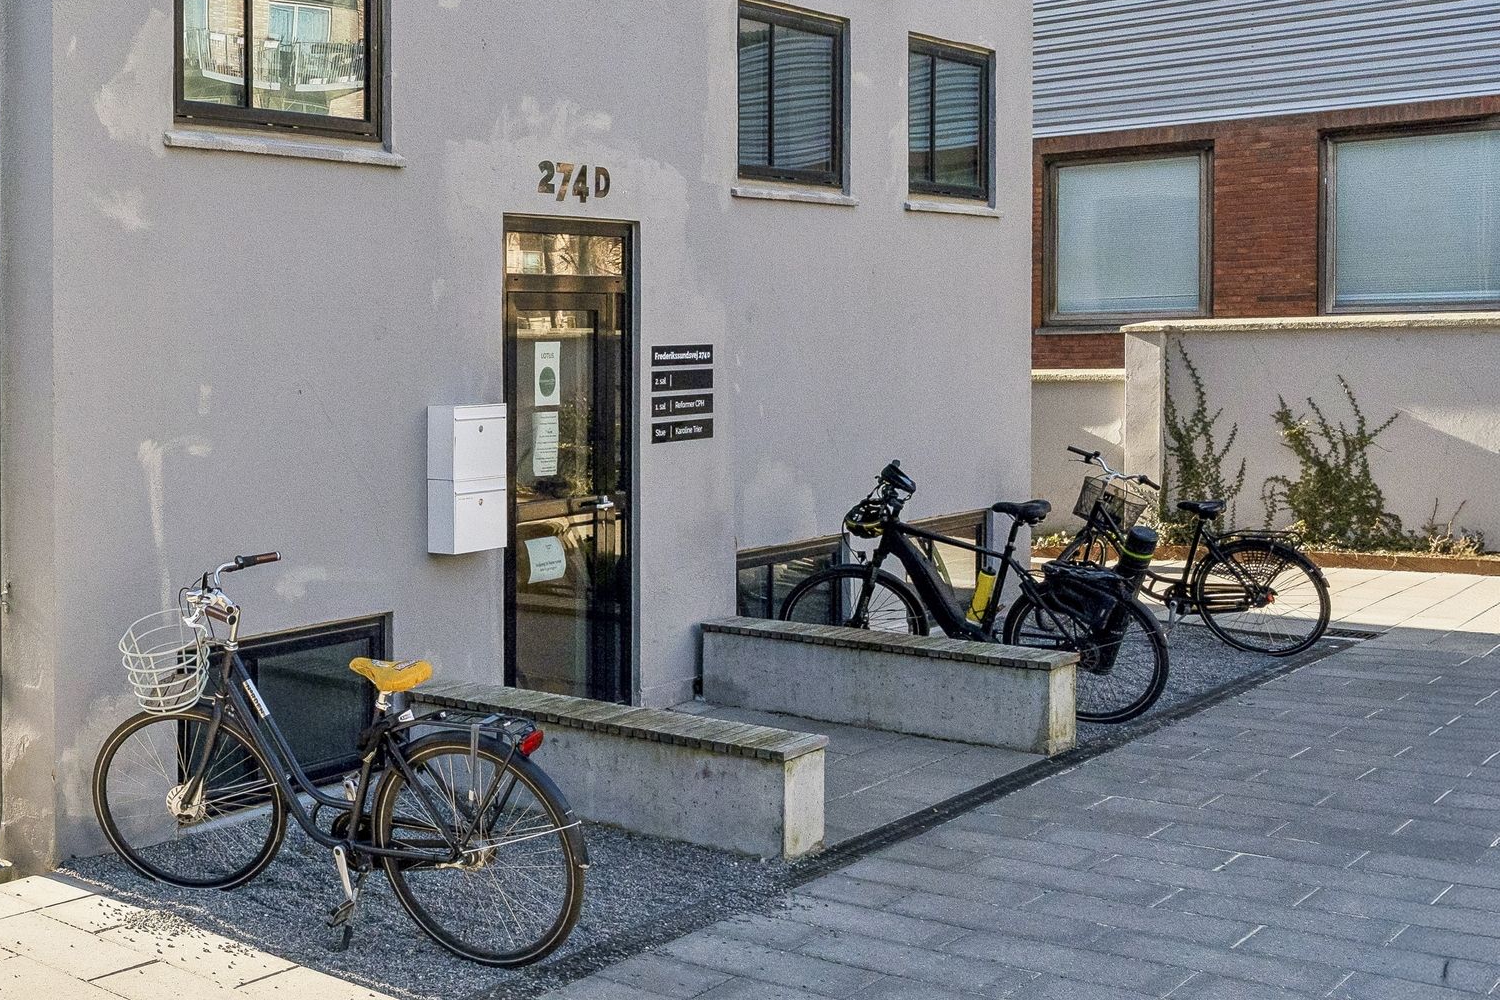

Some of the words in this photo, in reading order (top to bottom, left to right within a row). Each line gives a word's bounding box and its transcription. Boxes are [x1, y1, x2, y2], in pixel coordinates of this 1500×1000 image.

[654, 350, 698, 360] Frederikssundsvej
[675, 401, 695, 409] Reformer
[695, 399, 705, 407] CPH
[655, 429, 666, 437] Stue
[675, 426, 692, 435] Karoline
[693, 425, 703, 433] Trier
